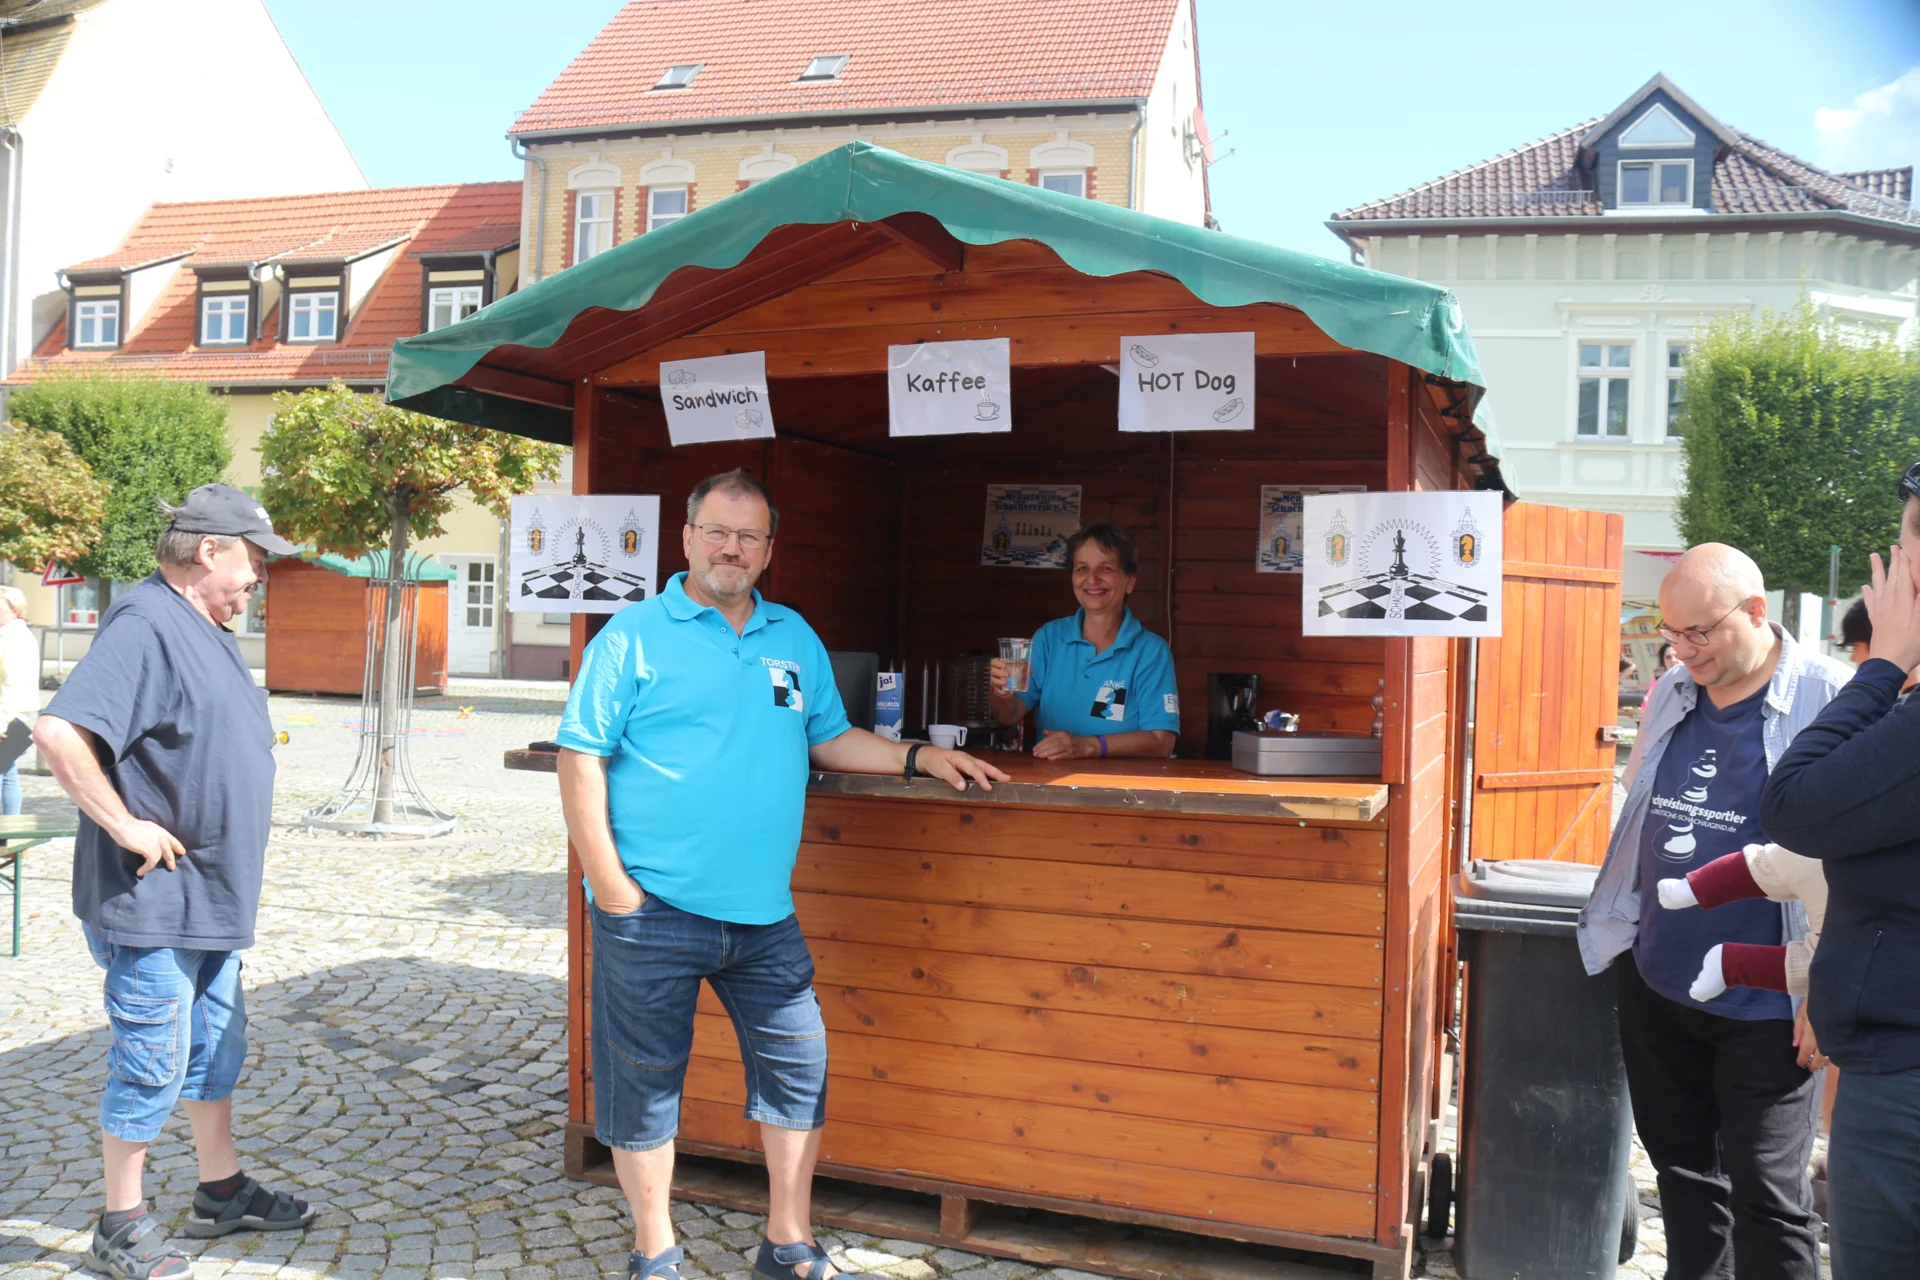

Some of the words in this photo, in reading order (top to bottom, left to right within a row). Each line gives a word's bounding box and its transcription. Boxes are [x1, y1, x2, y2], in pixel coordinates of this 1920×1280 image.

[906, 372, 986, 394] Kaffee
[1138, 372, 1183, 393] HOT
[1195, 370, 1236, 395] Dog
[672, 387, 758, 411] Sandwich
[1271, 505, 1303, 513] Schach
[879, 675, 893, 688] ja!
[1103, 680, 1125, 689] ANKE
